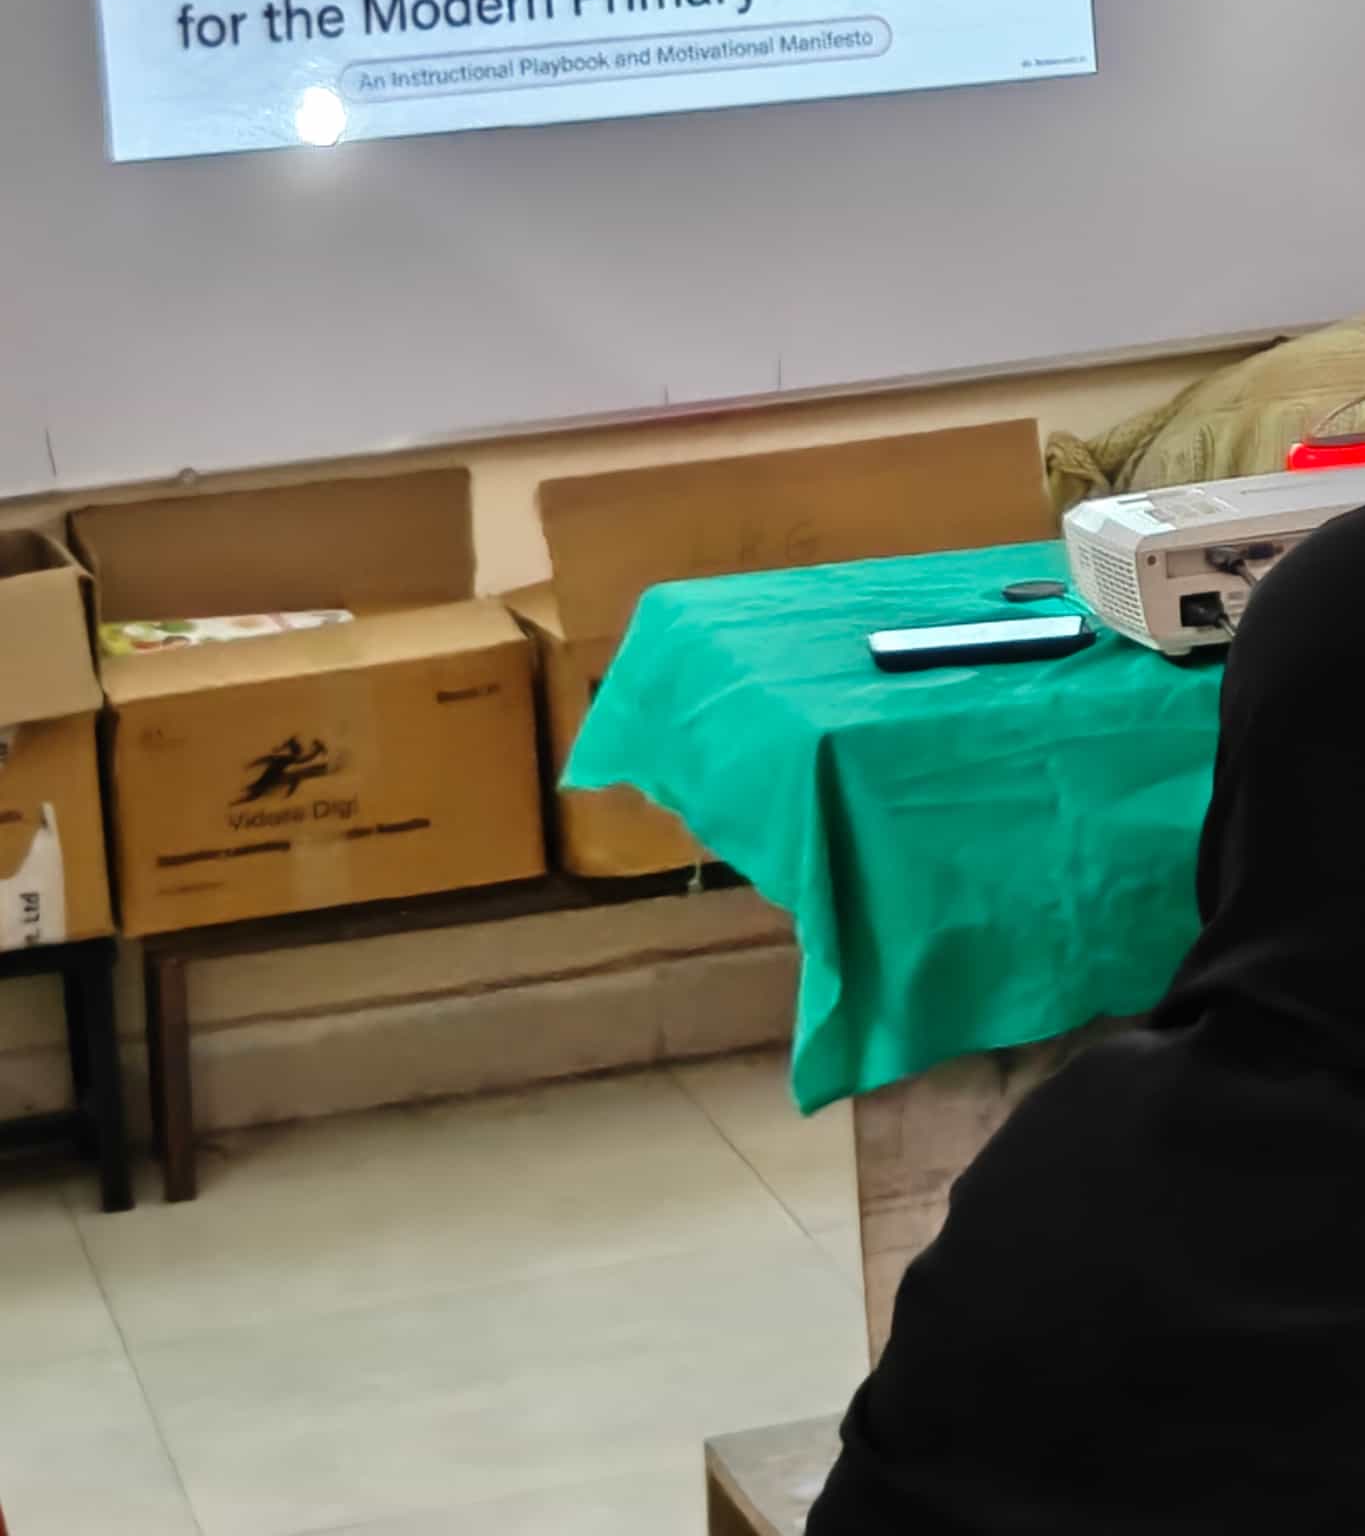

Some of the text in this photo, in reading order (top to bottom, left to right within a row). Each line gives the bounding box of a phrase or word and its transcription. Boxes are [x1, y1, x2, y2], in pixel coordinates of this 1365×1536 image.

[177, 4, 248, 50] for
[358, 29, 873, 92] An Instructional Playbook and Motivational Manifesto
